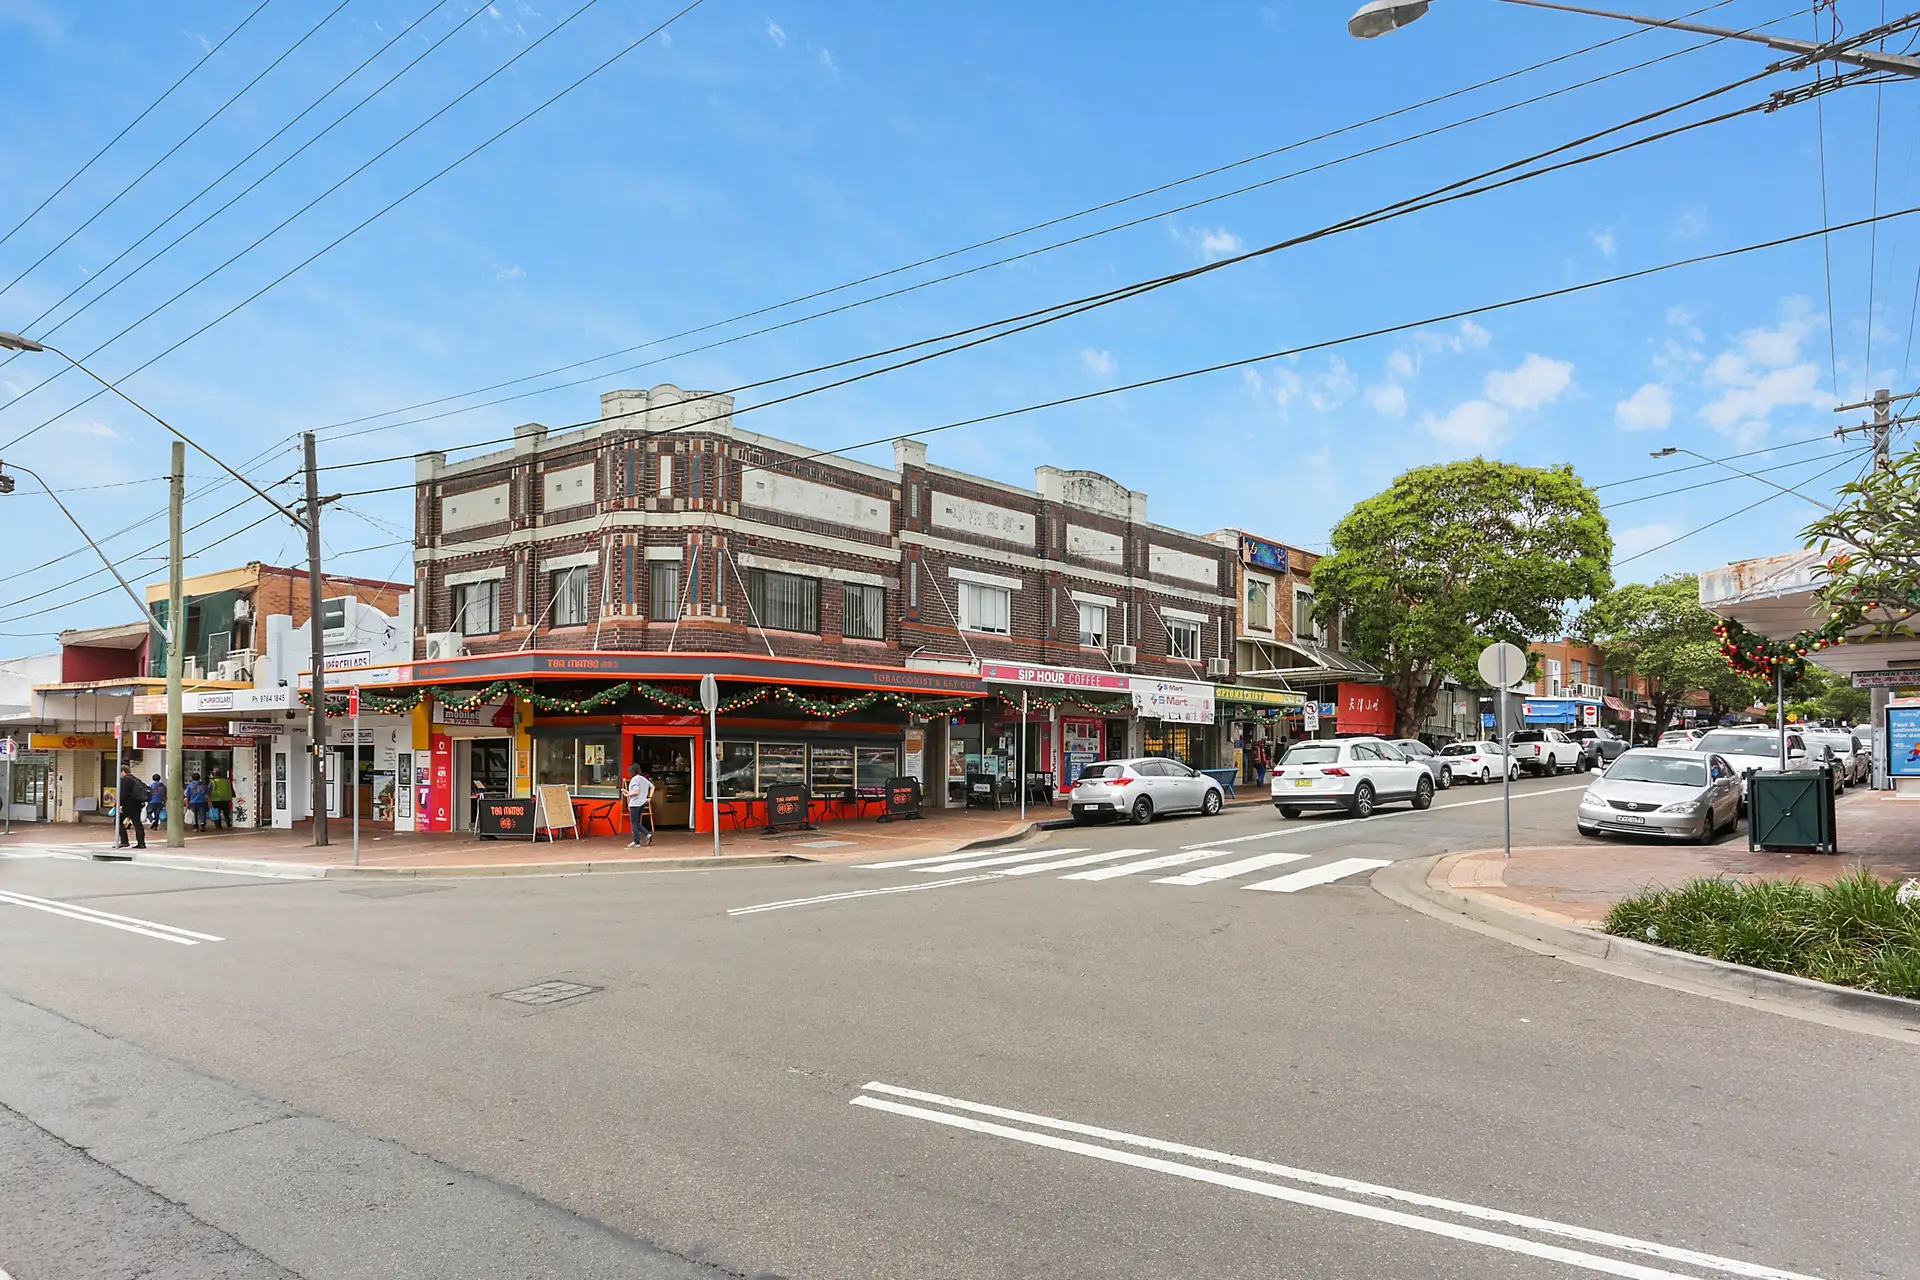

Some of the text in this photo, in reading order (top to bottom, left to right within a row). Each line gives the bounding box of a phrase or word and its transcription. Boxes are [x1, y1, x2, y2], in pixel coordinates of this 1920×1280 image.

[873, 673, 932, 686] TOBACCONIST
[943, 679, 959, 688] KEY
[960, 681, 977, 689] CUT
[1018, 669, 1100, 687] SIP HOUR COFFEE
[1166, 696, 1188, 706] Mart
